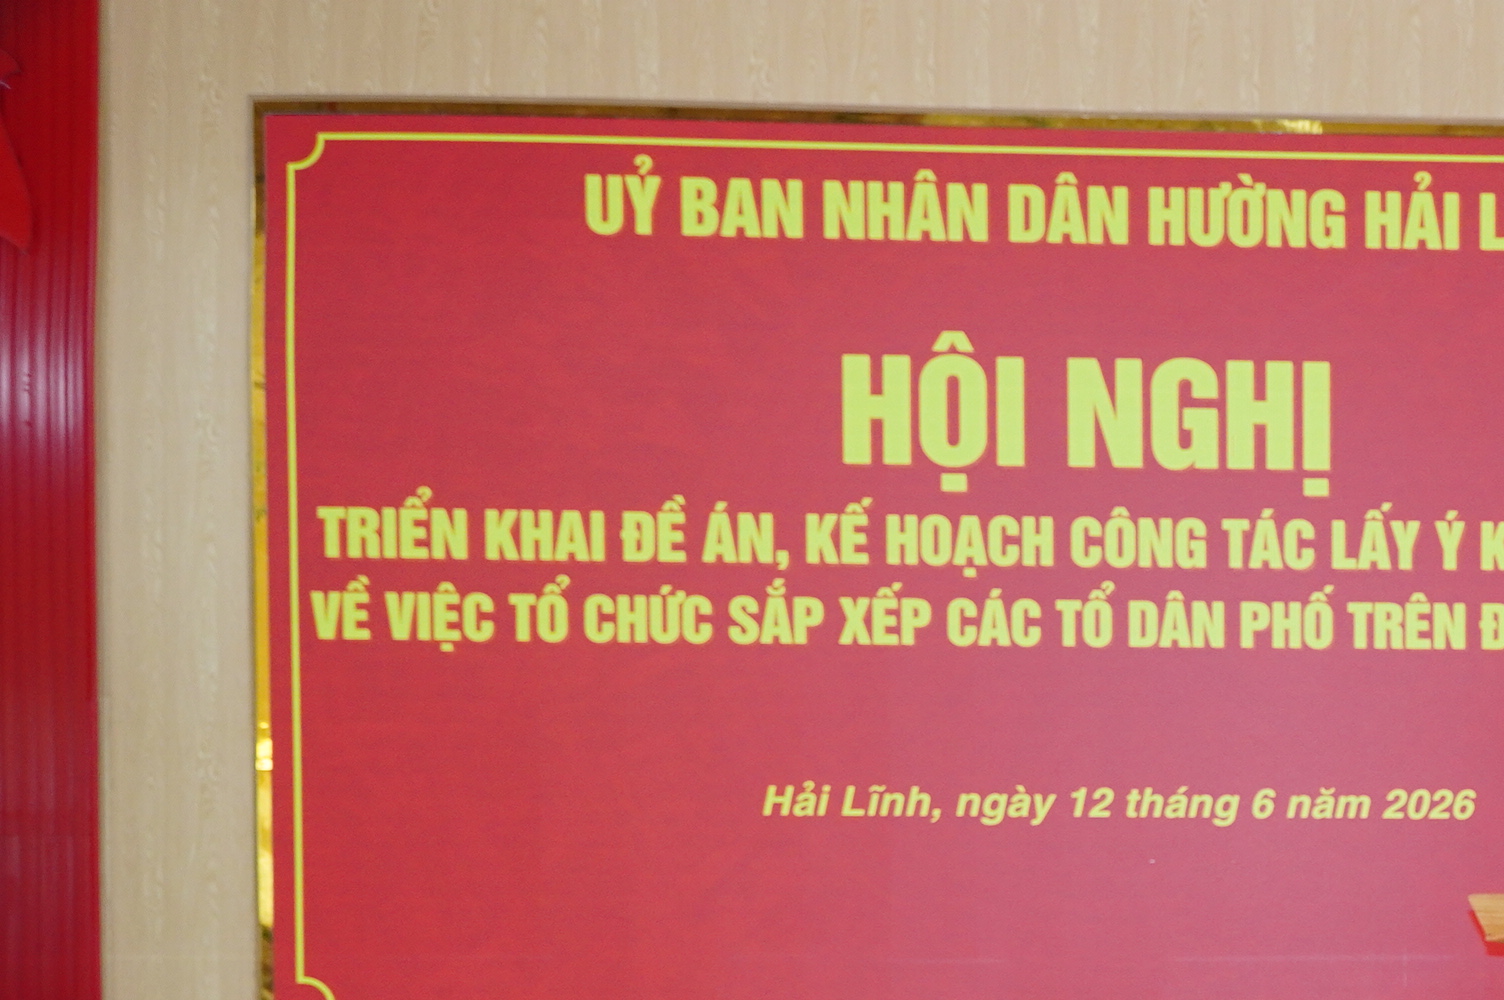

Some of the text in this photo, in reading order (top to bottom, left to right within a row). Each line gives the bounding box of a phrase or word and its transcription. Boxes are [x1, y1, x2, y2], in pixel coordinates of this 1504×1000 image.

[585, 154, 661, 235] UỶ
[680, 176, 804, 239] BAN
[823, 169, 989, 242] NHÂN
[1008, 172, 1129, 245] DÂN
[1148, 173, 1346, 249] HƯỜNG
[1365, 171, 1460, 250] HẢI
[841, 330, 1331, 497] HỘI NGHỊ
[317, 486, 468, 560] TRIỂN
[484, 509, 606, 562] KHAI
[620, 494, 687, 563] ĐỀ
[702, 501, 790, 570] ÁN,
[805, 497, 873, 565] KẾ
[885, 514, 1054, 578] HOẠCH
[1070, 506, 1207, 569] CÔNG
[1221, 508, 1315, 570] TÁC
[1331, 502, 1421, 570] LẤY
[1434, 510, 1465, 571] Ý
[310, 575, 371, 640] VỀ
[385, 582, 495, 652] VIỆC
[508, 574, 571, 643] TỔ
[583, 584, 713, 644] CHỨC
[728, 578, 825, 645] SẮP
[838, 582, 932, 646] XẾP
[947, 588, 1042, 647] CÁC
[1055, 581, 1115, 648] TỔ
[1128, 590, 1225, 648] DÂN
[1240, 585, 1334, 650] PHỐ
[1347, 592, 1467, 650] TRÊN
[762, 780, 1477, 827] Hải Lĩnh, ngày 12 tháng 6 năm 2026
